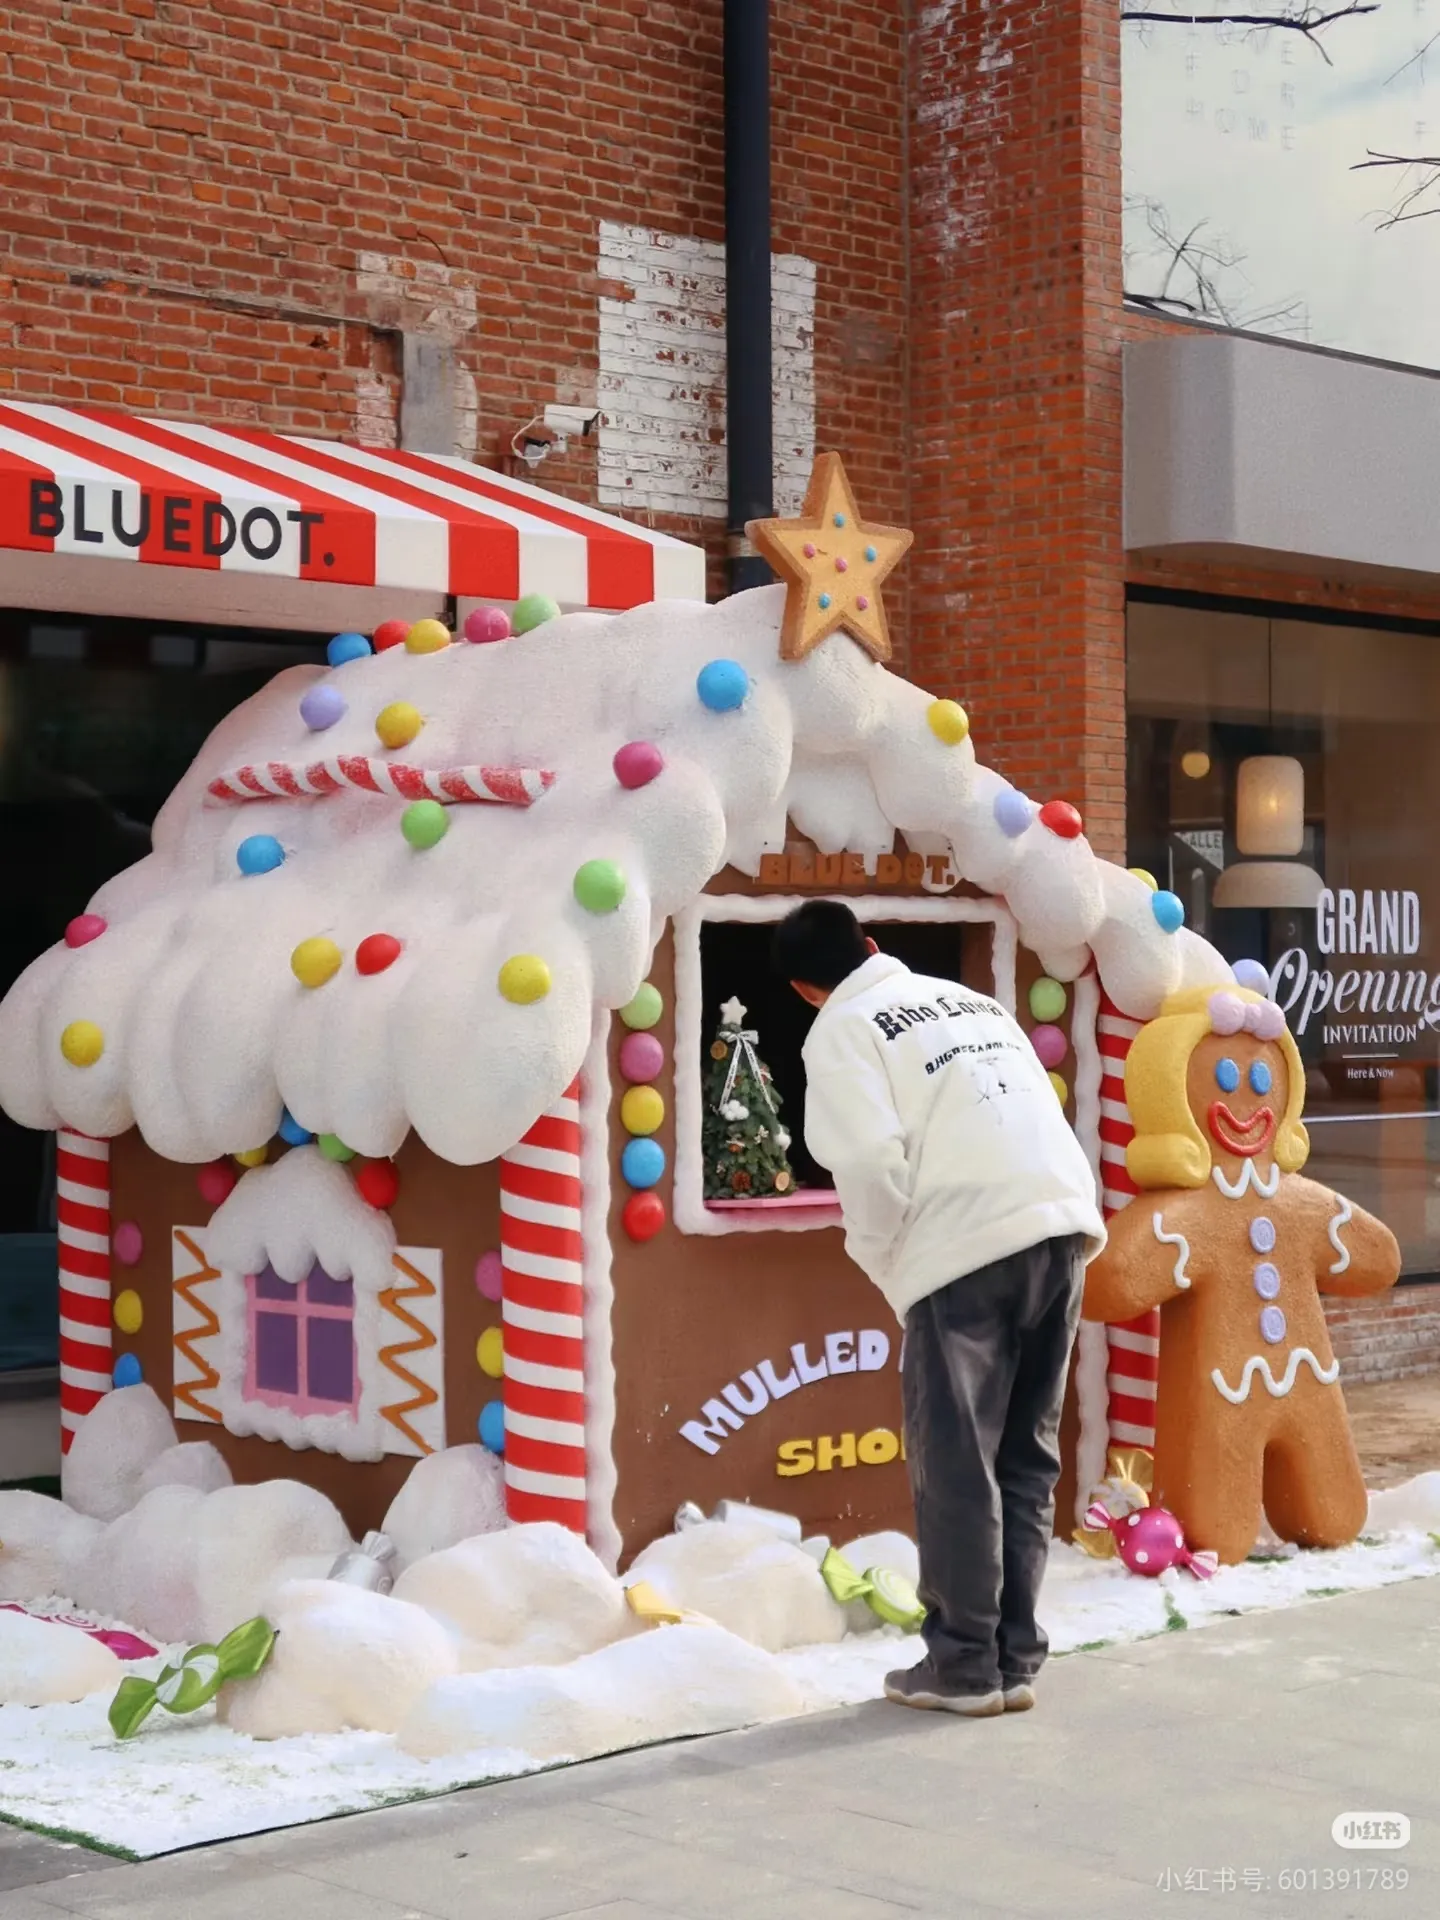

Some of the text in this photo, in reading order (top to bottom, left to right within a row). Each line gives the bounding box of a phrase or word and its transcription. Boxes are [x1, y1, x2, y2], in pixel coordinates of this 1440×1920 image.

[30, 479, 335, 567] BLUEDOT.
[760, 852, 955, 885] BLUE DOT.
[1317, 887, 1420, 955] GRAND
[1323, 1024, 1418, 1045] INVITATION
[1347, 1067, 1367, 1079] Here
[1376, 1067, 1395, 1079] Now
[678, 1329, 890, 1456] MULLED
[776, 1428, 906, 1477] SHO
